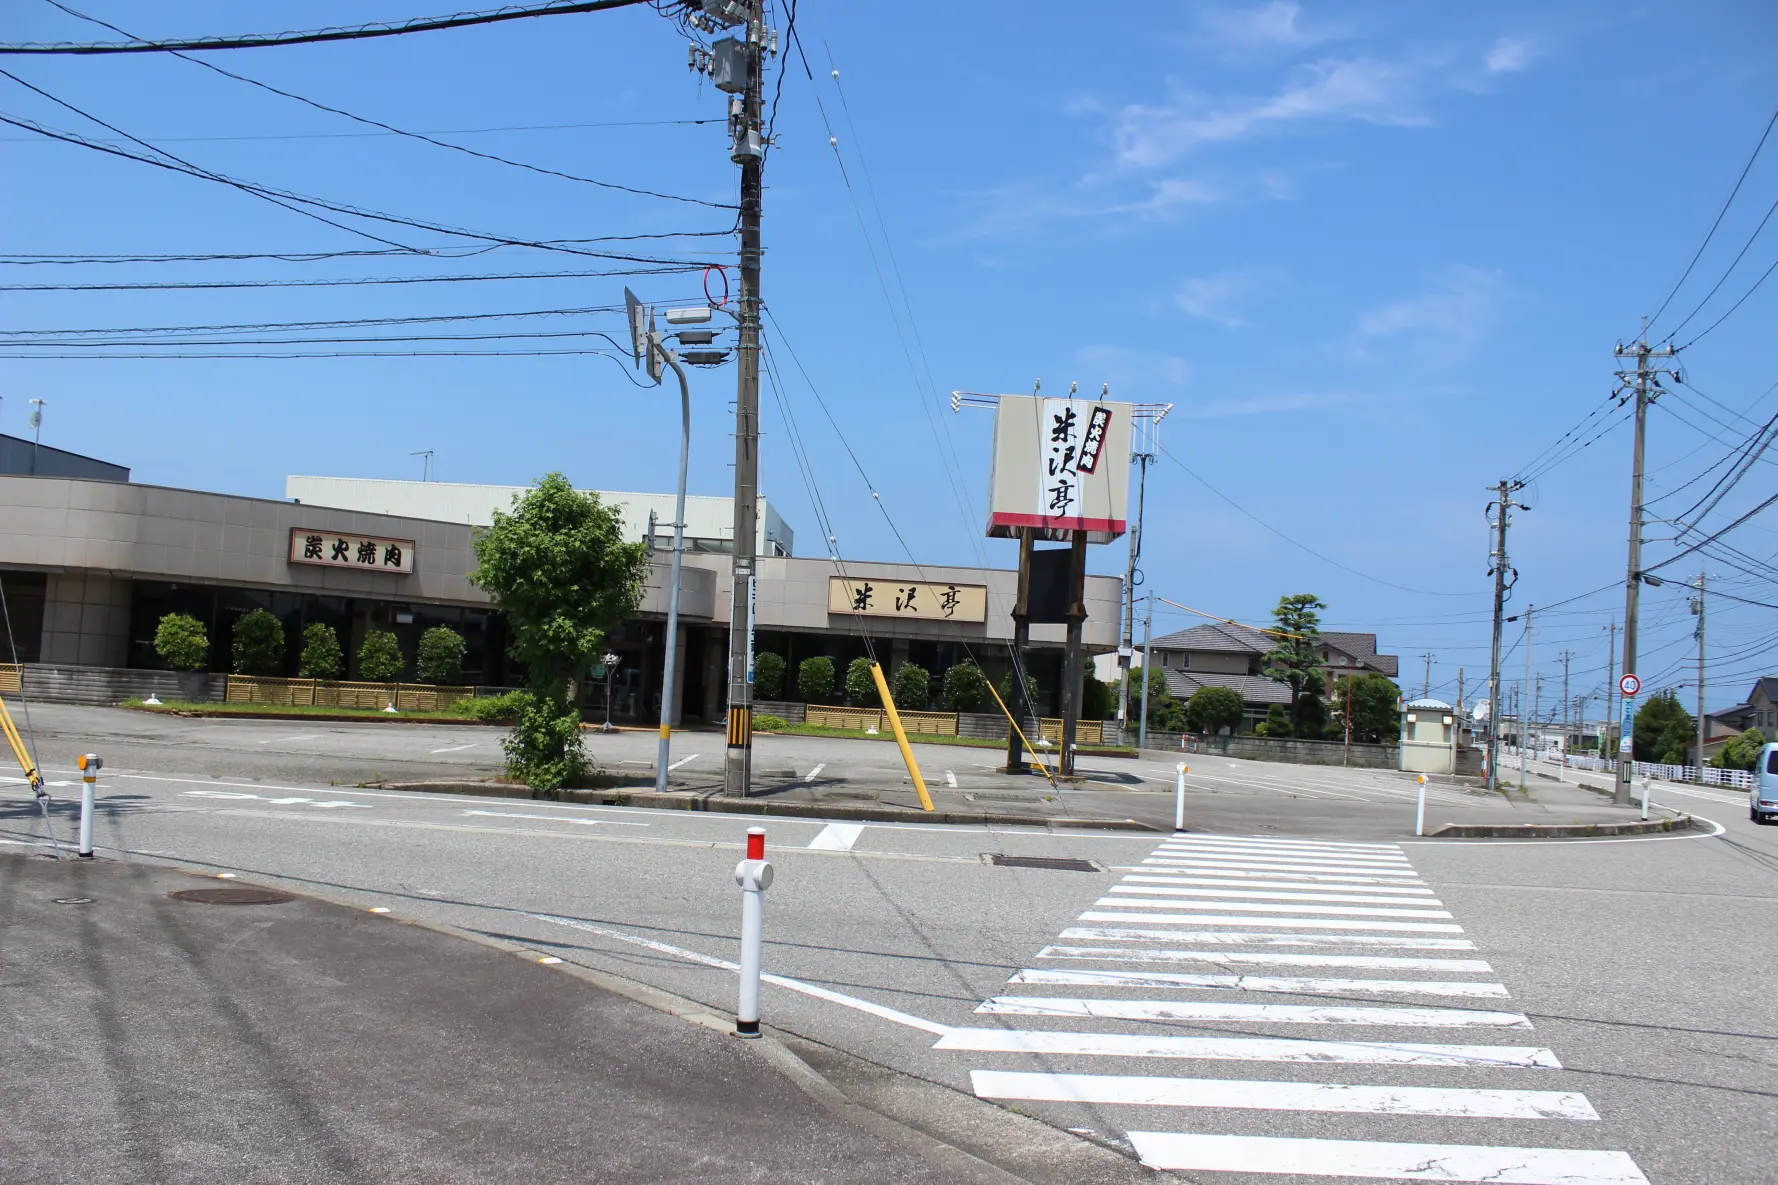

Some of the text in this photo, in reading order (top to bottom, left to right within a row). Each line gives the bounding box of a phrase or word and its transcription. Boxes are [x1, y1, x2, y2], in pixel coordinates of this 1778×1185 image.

[1080, 411, 1107, 469] 炭火焼肉
[1048, 407, 1077, 520] 米沢亭
[304, 535, 402, 568] 炭火焼肉
[853, 582, 961, 618] 米沢亭
[1624, 680, 1637, 690] 40
[1623, 701, 1632, 737] KUMON
